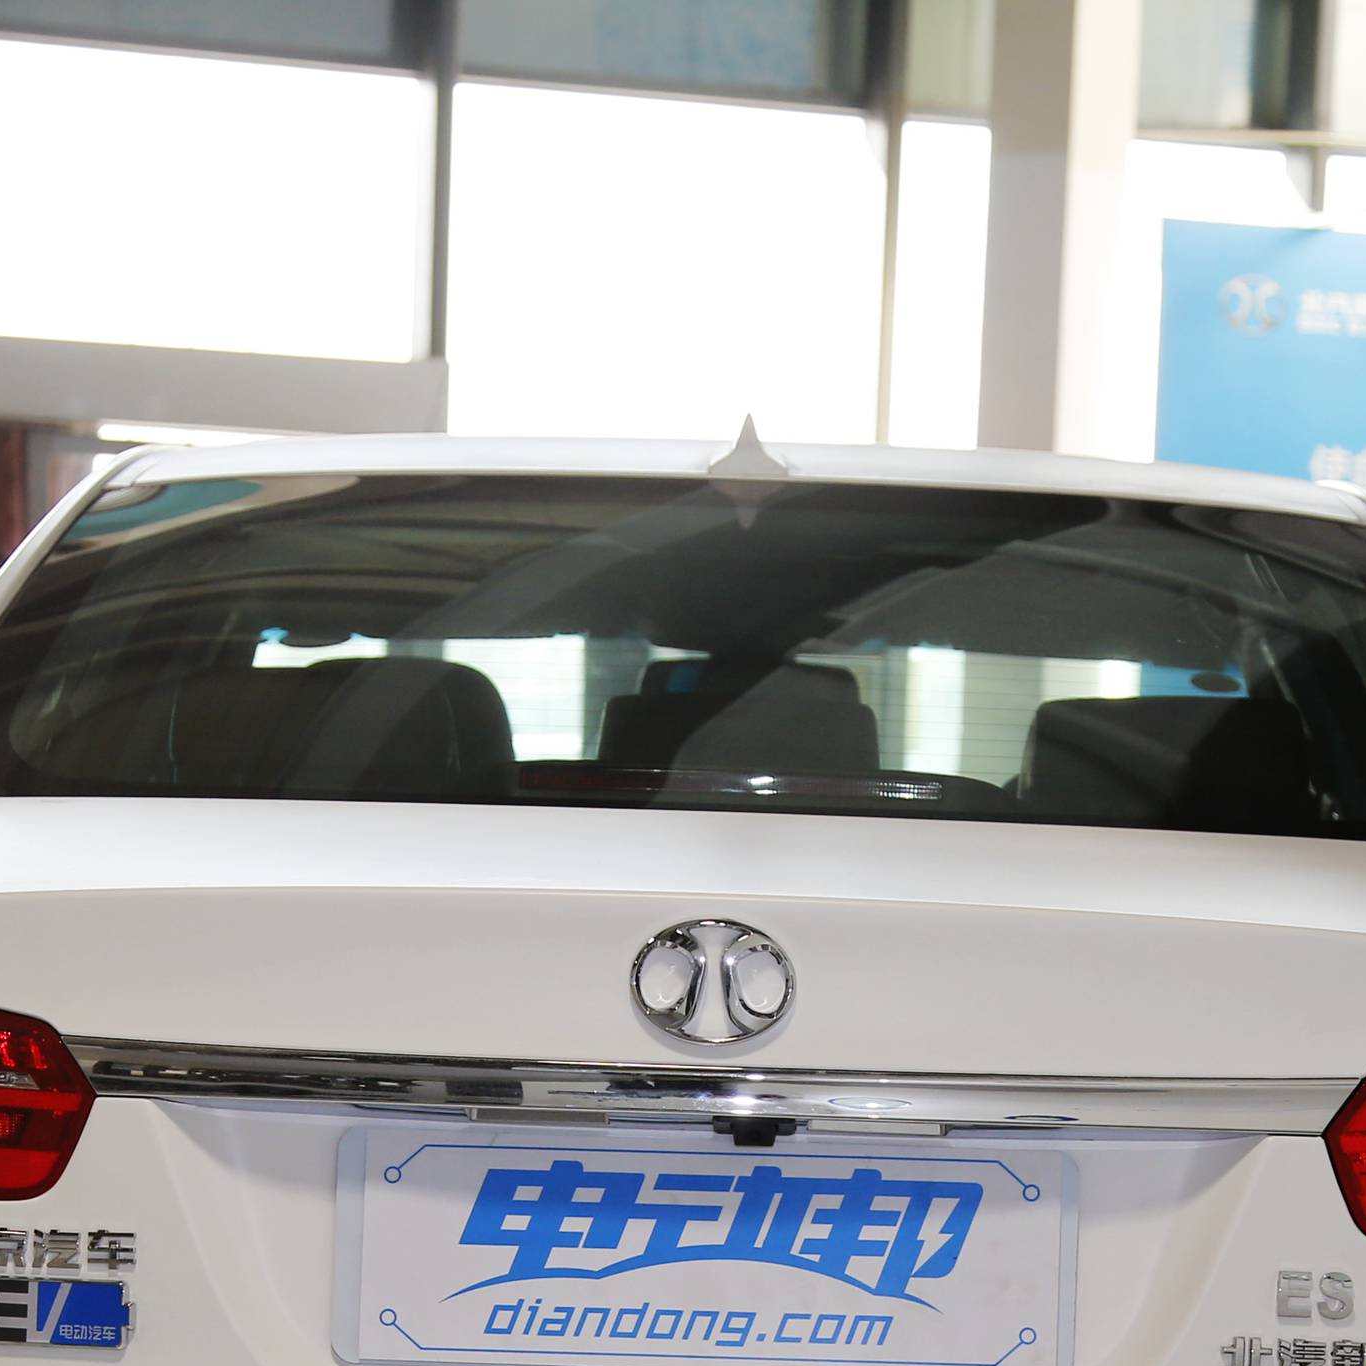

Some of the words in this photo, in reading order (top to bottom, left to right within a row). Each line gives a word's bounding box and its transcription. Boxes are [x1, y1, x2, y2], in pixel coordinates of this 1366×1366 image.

[1275, 1269, 1355, 1320] ES
[59, 1324, 117, 1341] 电动汽车
[483, 1300, 893, 1347] diandong.com
